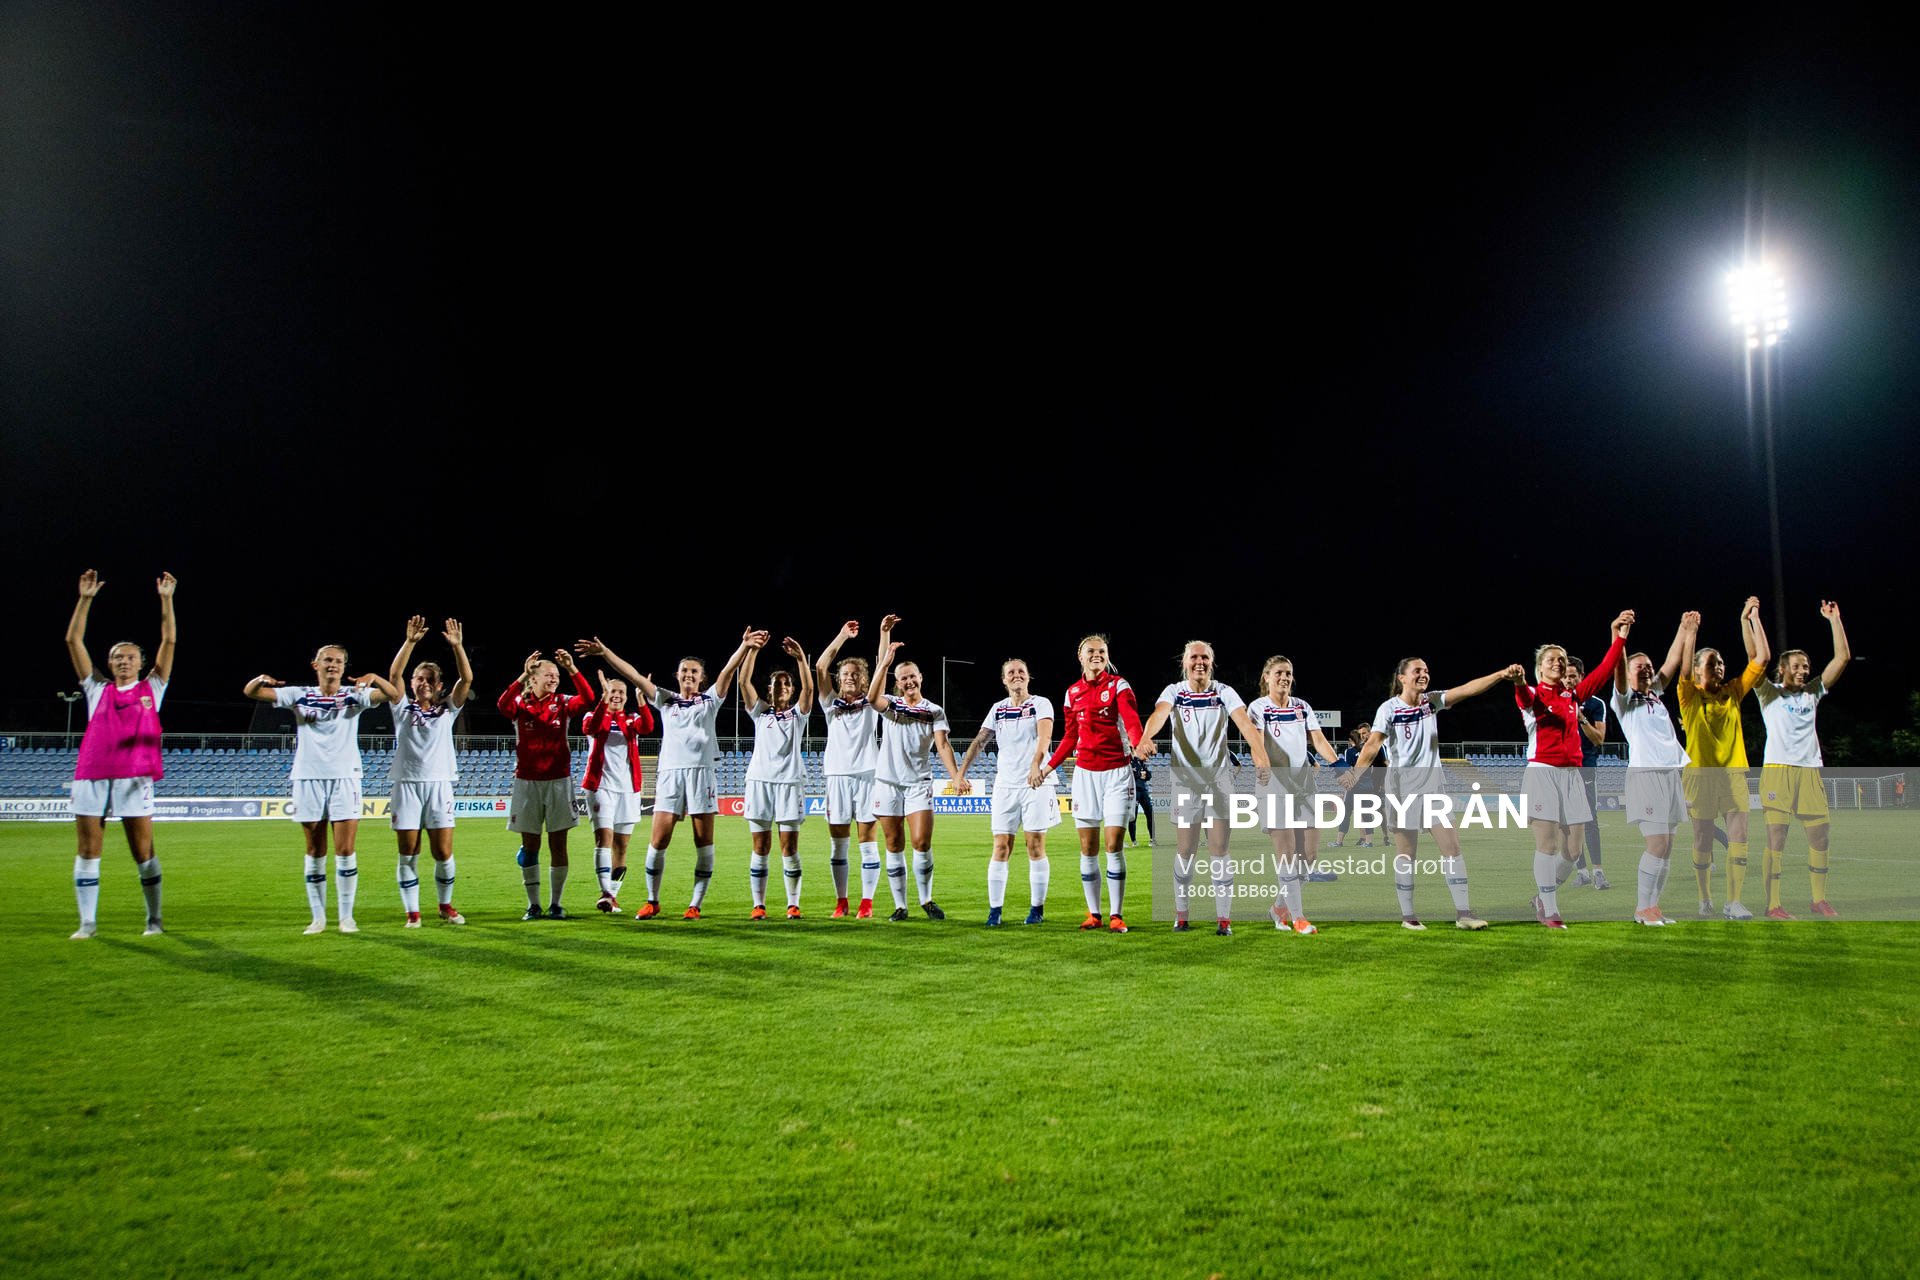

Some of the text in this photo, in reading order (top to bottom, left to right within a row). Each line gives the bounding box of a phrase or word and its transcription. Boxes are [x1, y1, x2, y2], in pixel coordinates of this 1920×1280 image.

[767, 717, 775, 729] 2
[1183, 709, 1191, 723] 3
[1273, 723, 1281, 737] 6
[1404, 724, 1412, 740] 8
[0, 802, 35, 811] RCO
